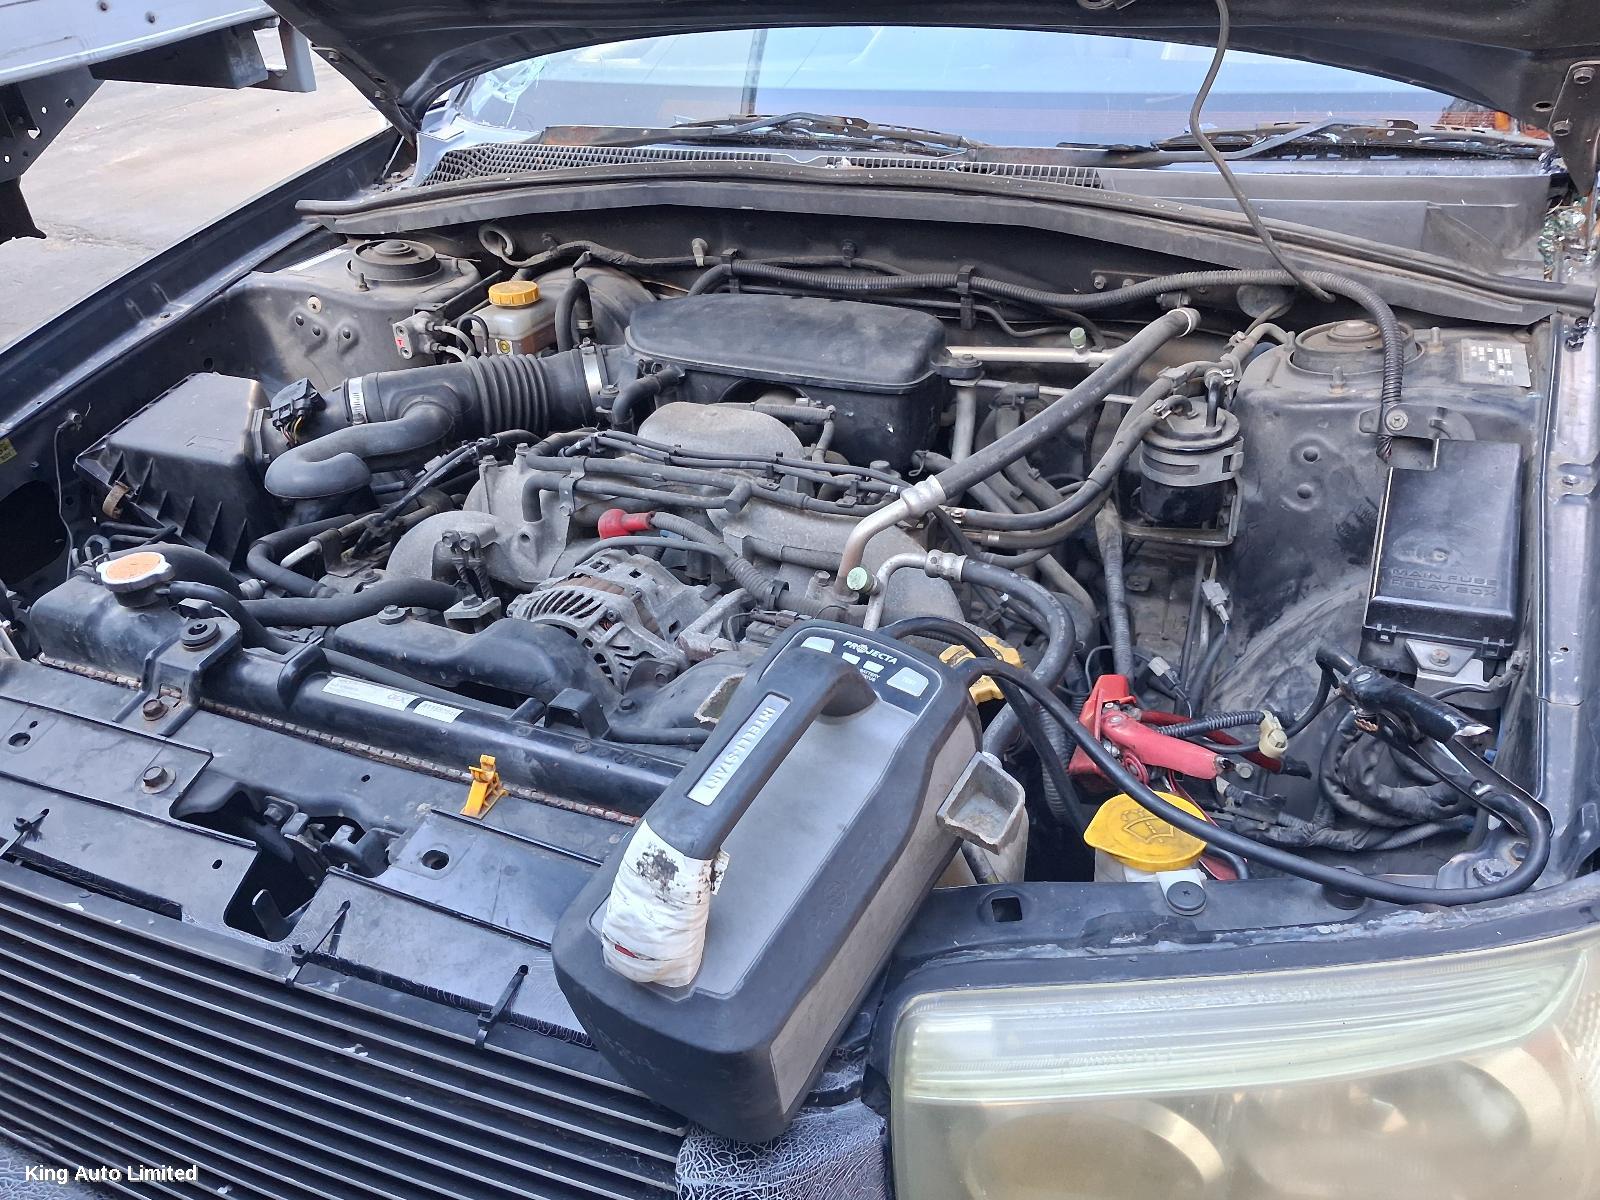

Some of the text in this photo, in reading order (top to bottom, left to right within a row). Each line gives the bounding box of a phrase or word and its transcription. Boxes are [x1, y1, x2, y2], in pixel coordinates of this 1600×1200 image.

[1392, 568, 1442, 580] MAIN
[1455, 586, 1498, 597] BOX
[843, 641, 898, 664] PROJECTA
